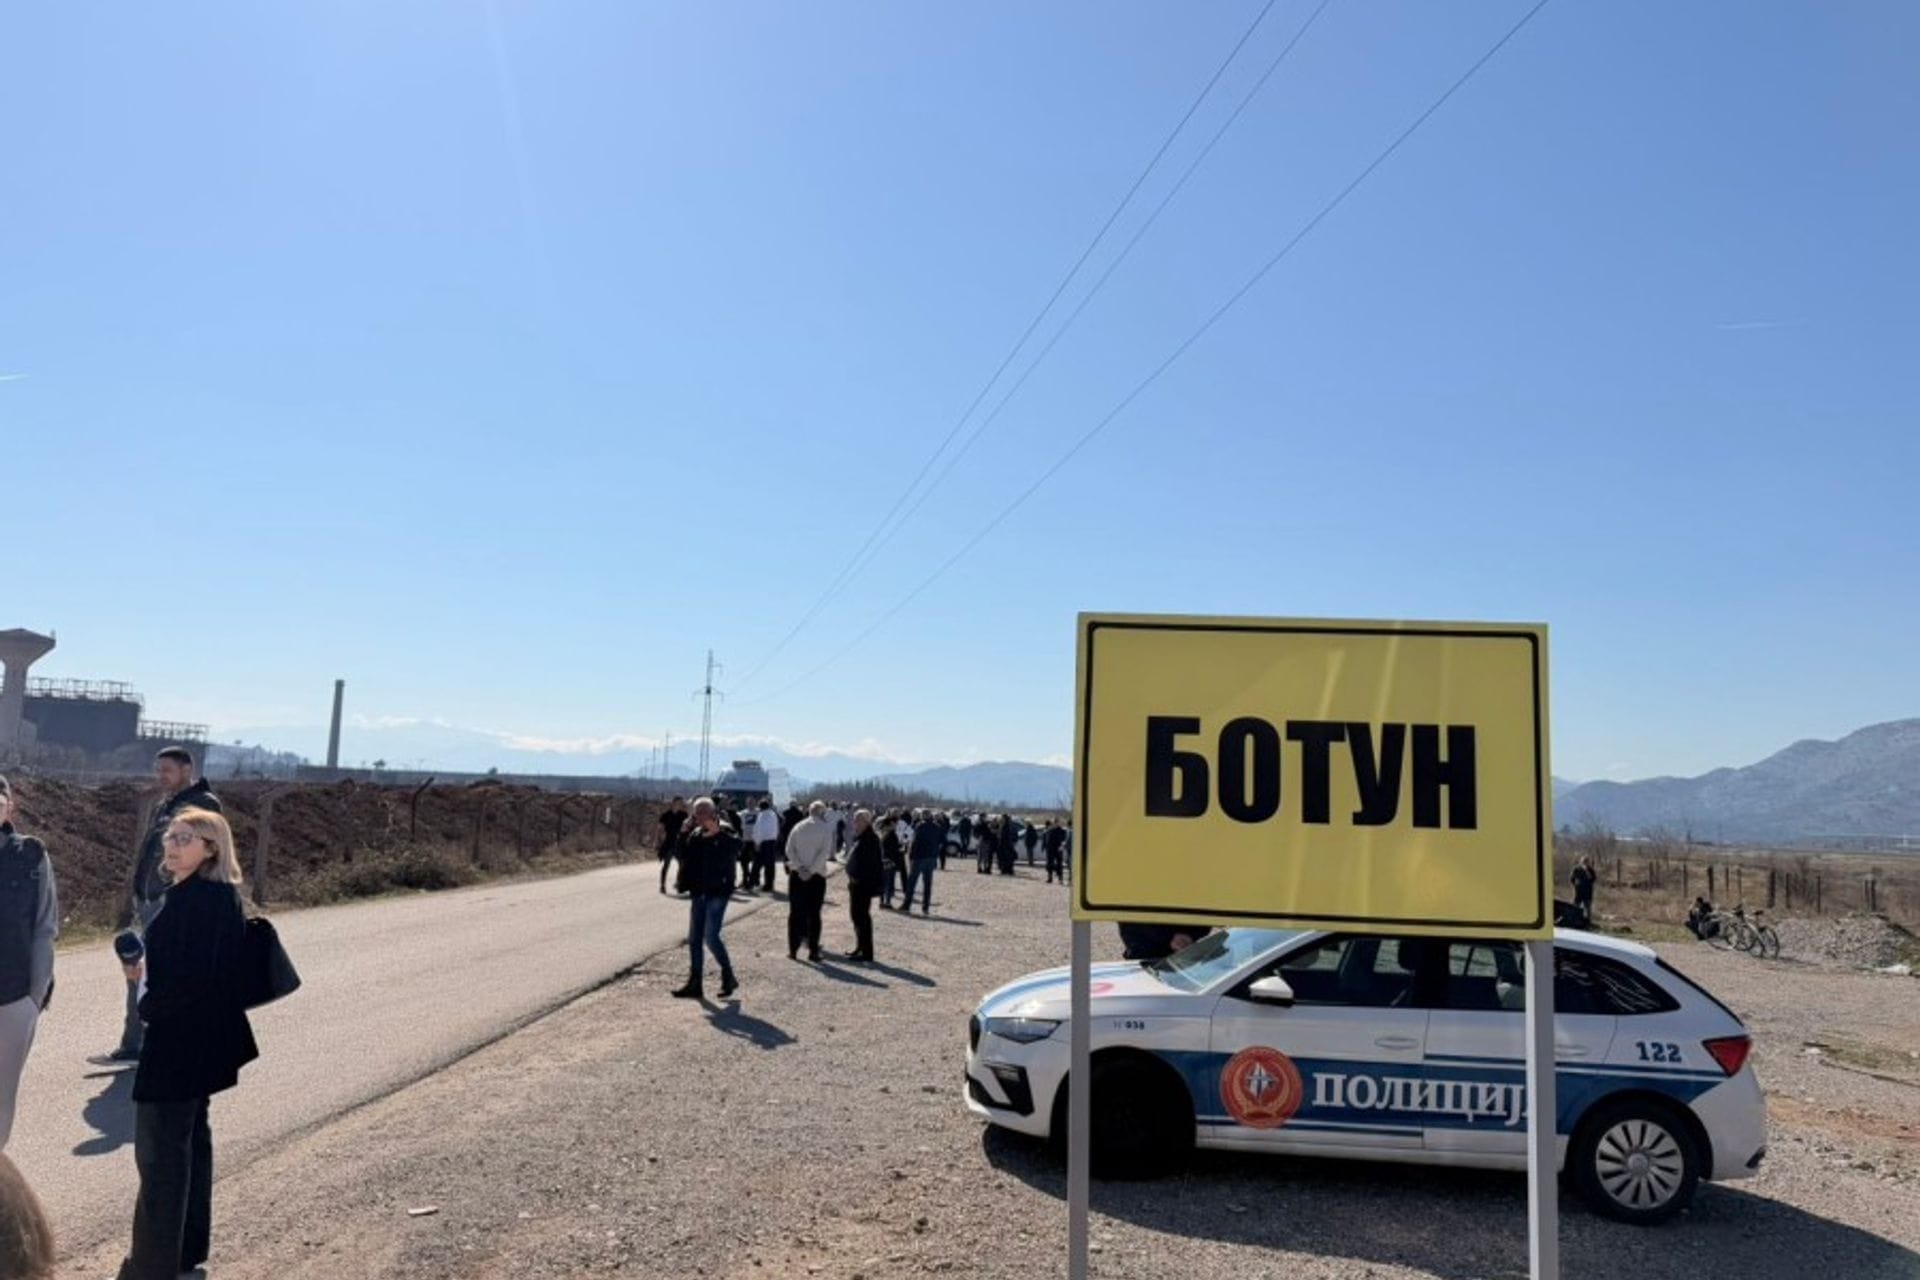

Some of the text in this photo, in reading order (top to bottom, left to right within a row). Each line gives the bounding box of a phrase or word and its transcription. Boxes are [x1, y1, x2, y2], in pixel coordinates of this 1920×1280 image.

[1145, 716, 1477, 830] БОТУН
[1635, 1041, 1682, 1063] 122
[1311, 1072, 1527, 1126] ПОЛИЦИЈ
